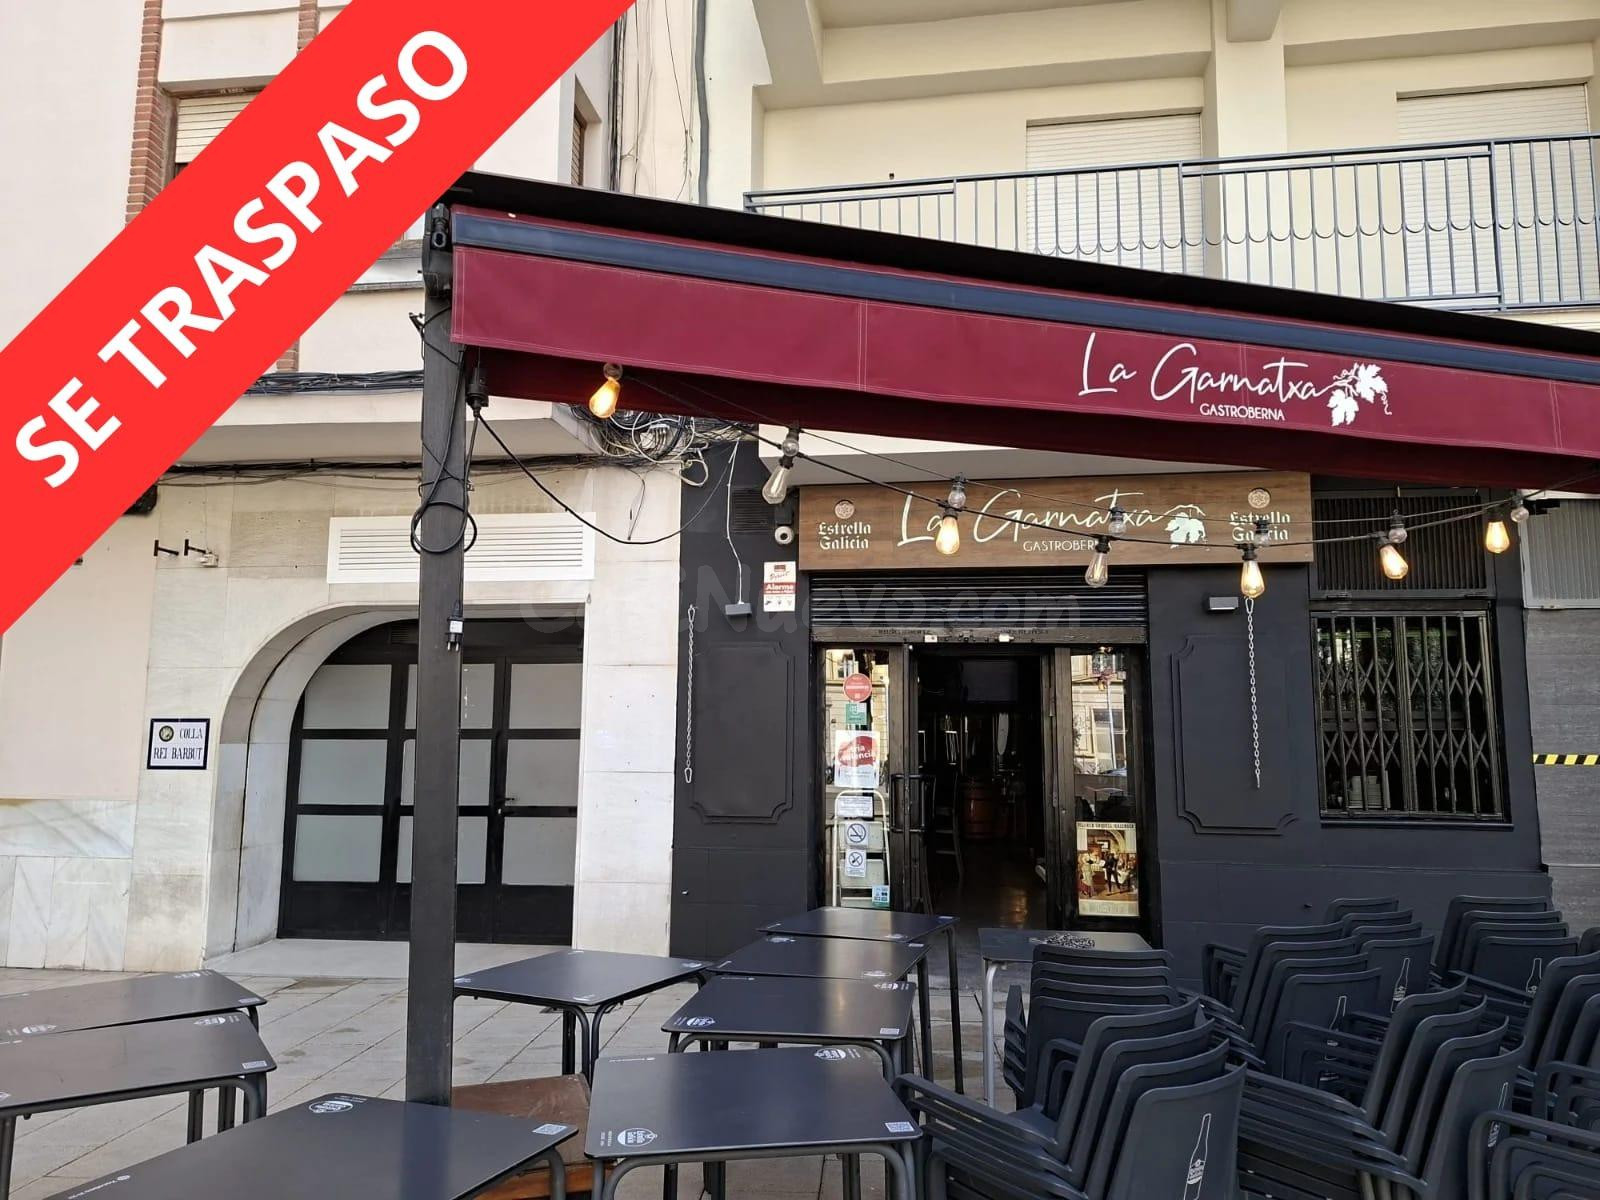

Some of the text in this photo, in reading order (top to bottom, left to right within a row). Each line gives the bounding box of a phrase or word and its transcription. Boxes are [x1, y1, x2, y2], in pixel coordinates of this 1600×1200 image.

[1077, 331, 1326, 404] La Garnatxa
[1199, 403, 1285, 421] GASTROBERNA
[897, 491, 944, 546] La
[1229, 511, 1291, 526] Estrella
[818, 521, 872, 536] Estrella
[1231, 526, 1289, 542] Gacia
[820, 535, 870, 550] Galicia
[179, 727, 203, 740] COLLA
[153, 747, 203, 760] REI BARBUT
